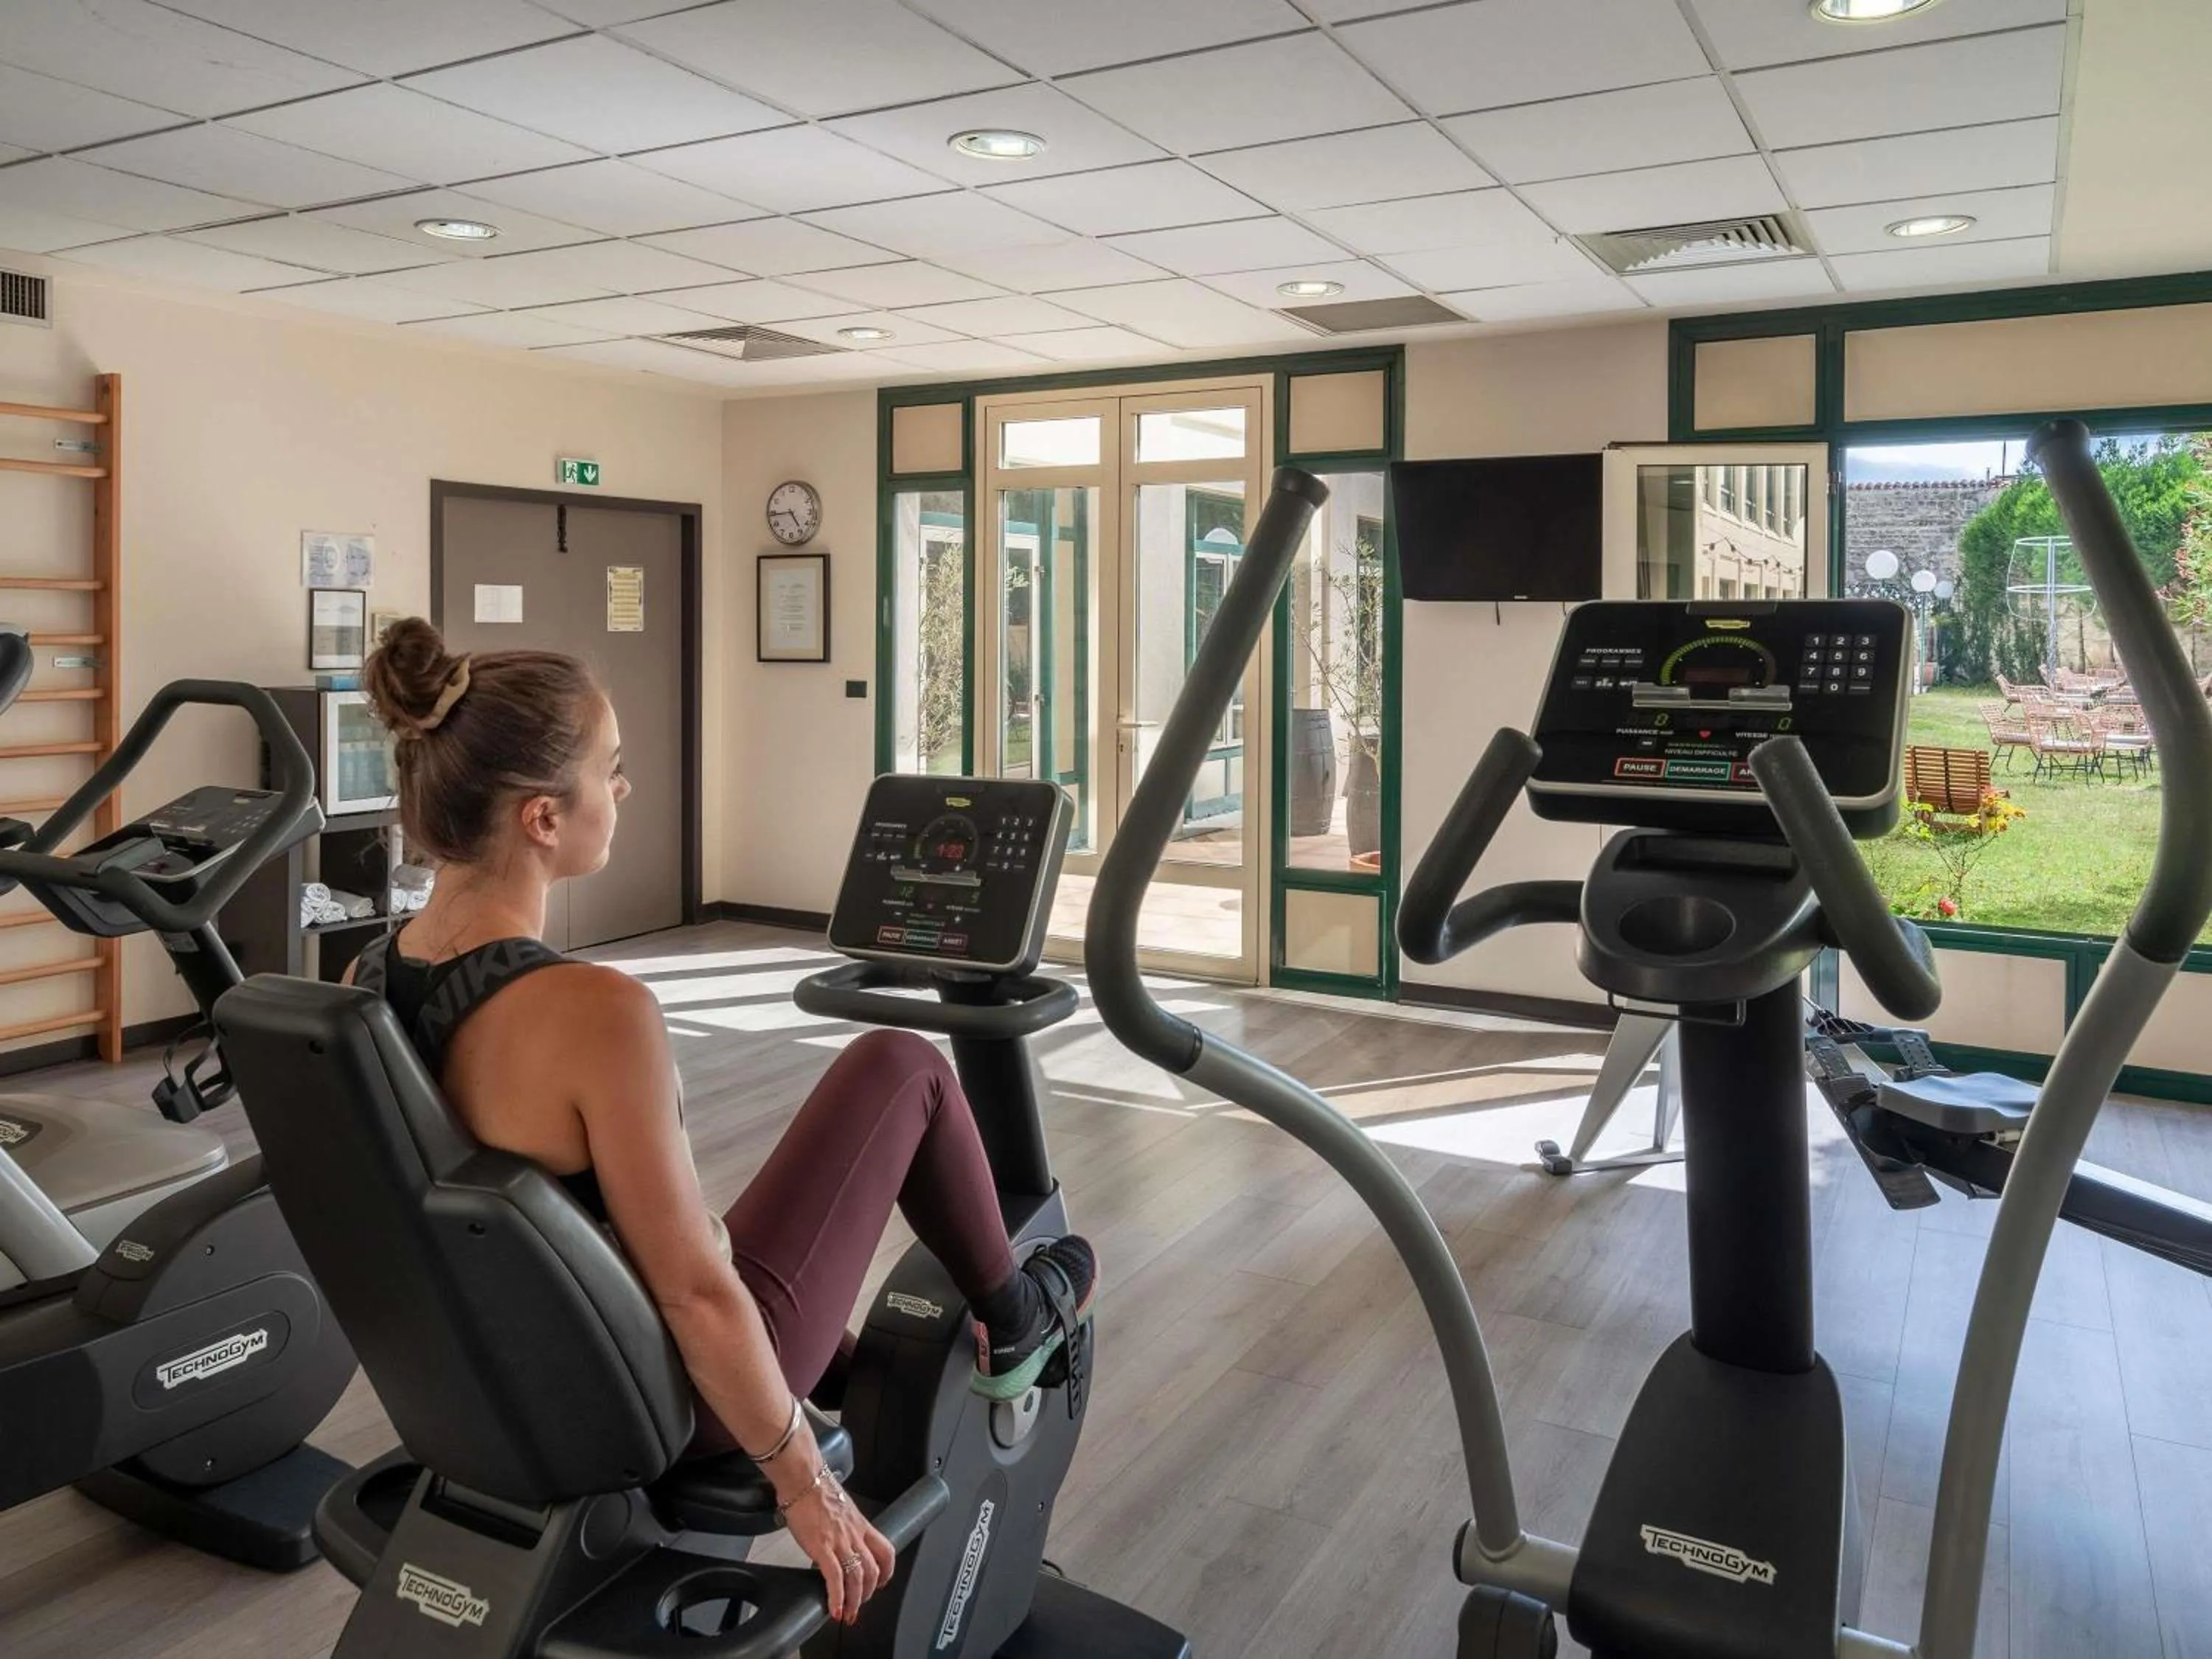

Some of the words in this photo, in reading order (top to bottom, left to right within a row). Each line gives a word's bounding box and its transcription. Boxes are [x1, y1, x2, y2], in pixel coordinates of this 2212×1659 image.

[1813, 636, 1819, 645] 1
[1836, 636, 1845, 645] 2
[1861, 636, 1869, 645] 3
[1809, 651, 1818, 660] 4
[1834, 651, 1843, 660] 5
[1859, 652, 1868, 661] 6
[1806, 667, 1815, 675] 7
[1832, 667, 1840, 676] 8
[1857, 667, 1866, 676] 9
[1829, 683, 1839, 692] 0
[1778, 717, 1792, 731] 0
[1623, 762, 1657, 772] PAUSE
[1669, 765, 1727, 775] DEMARRAGE
